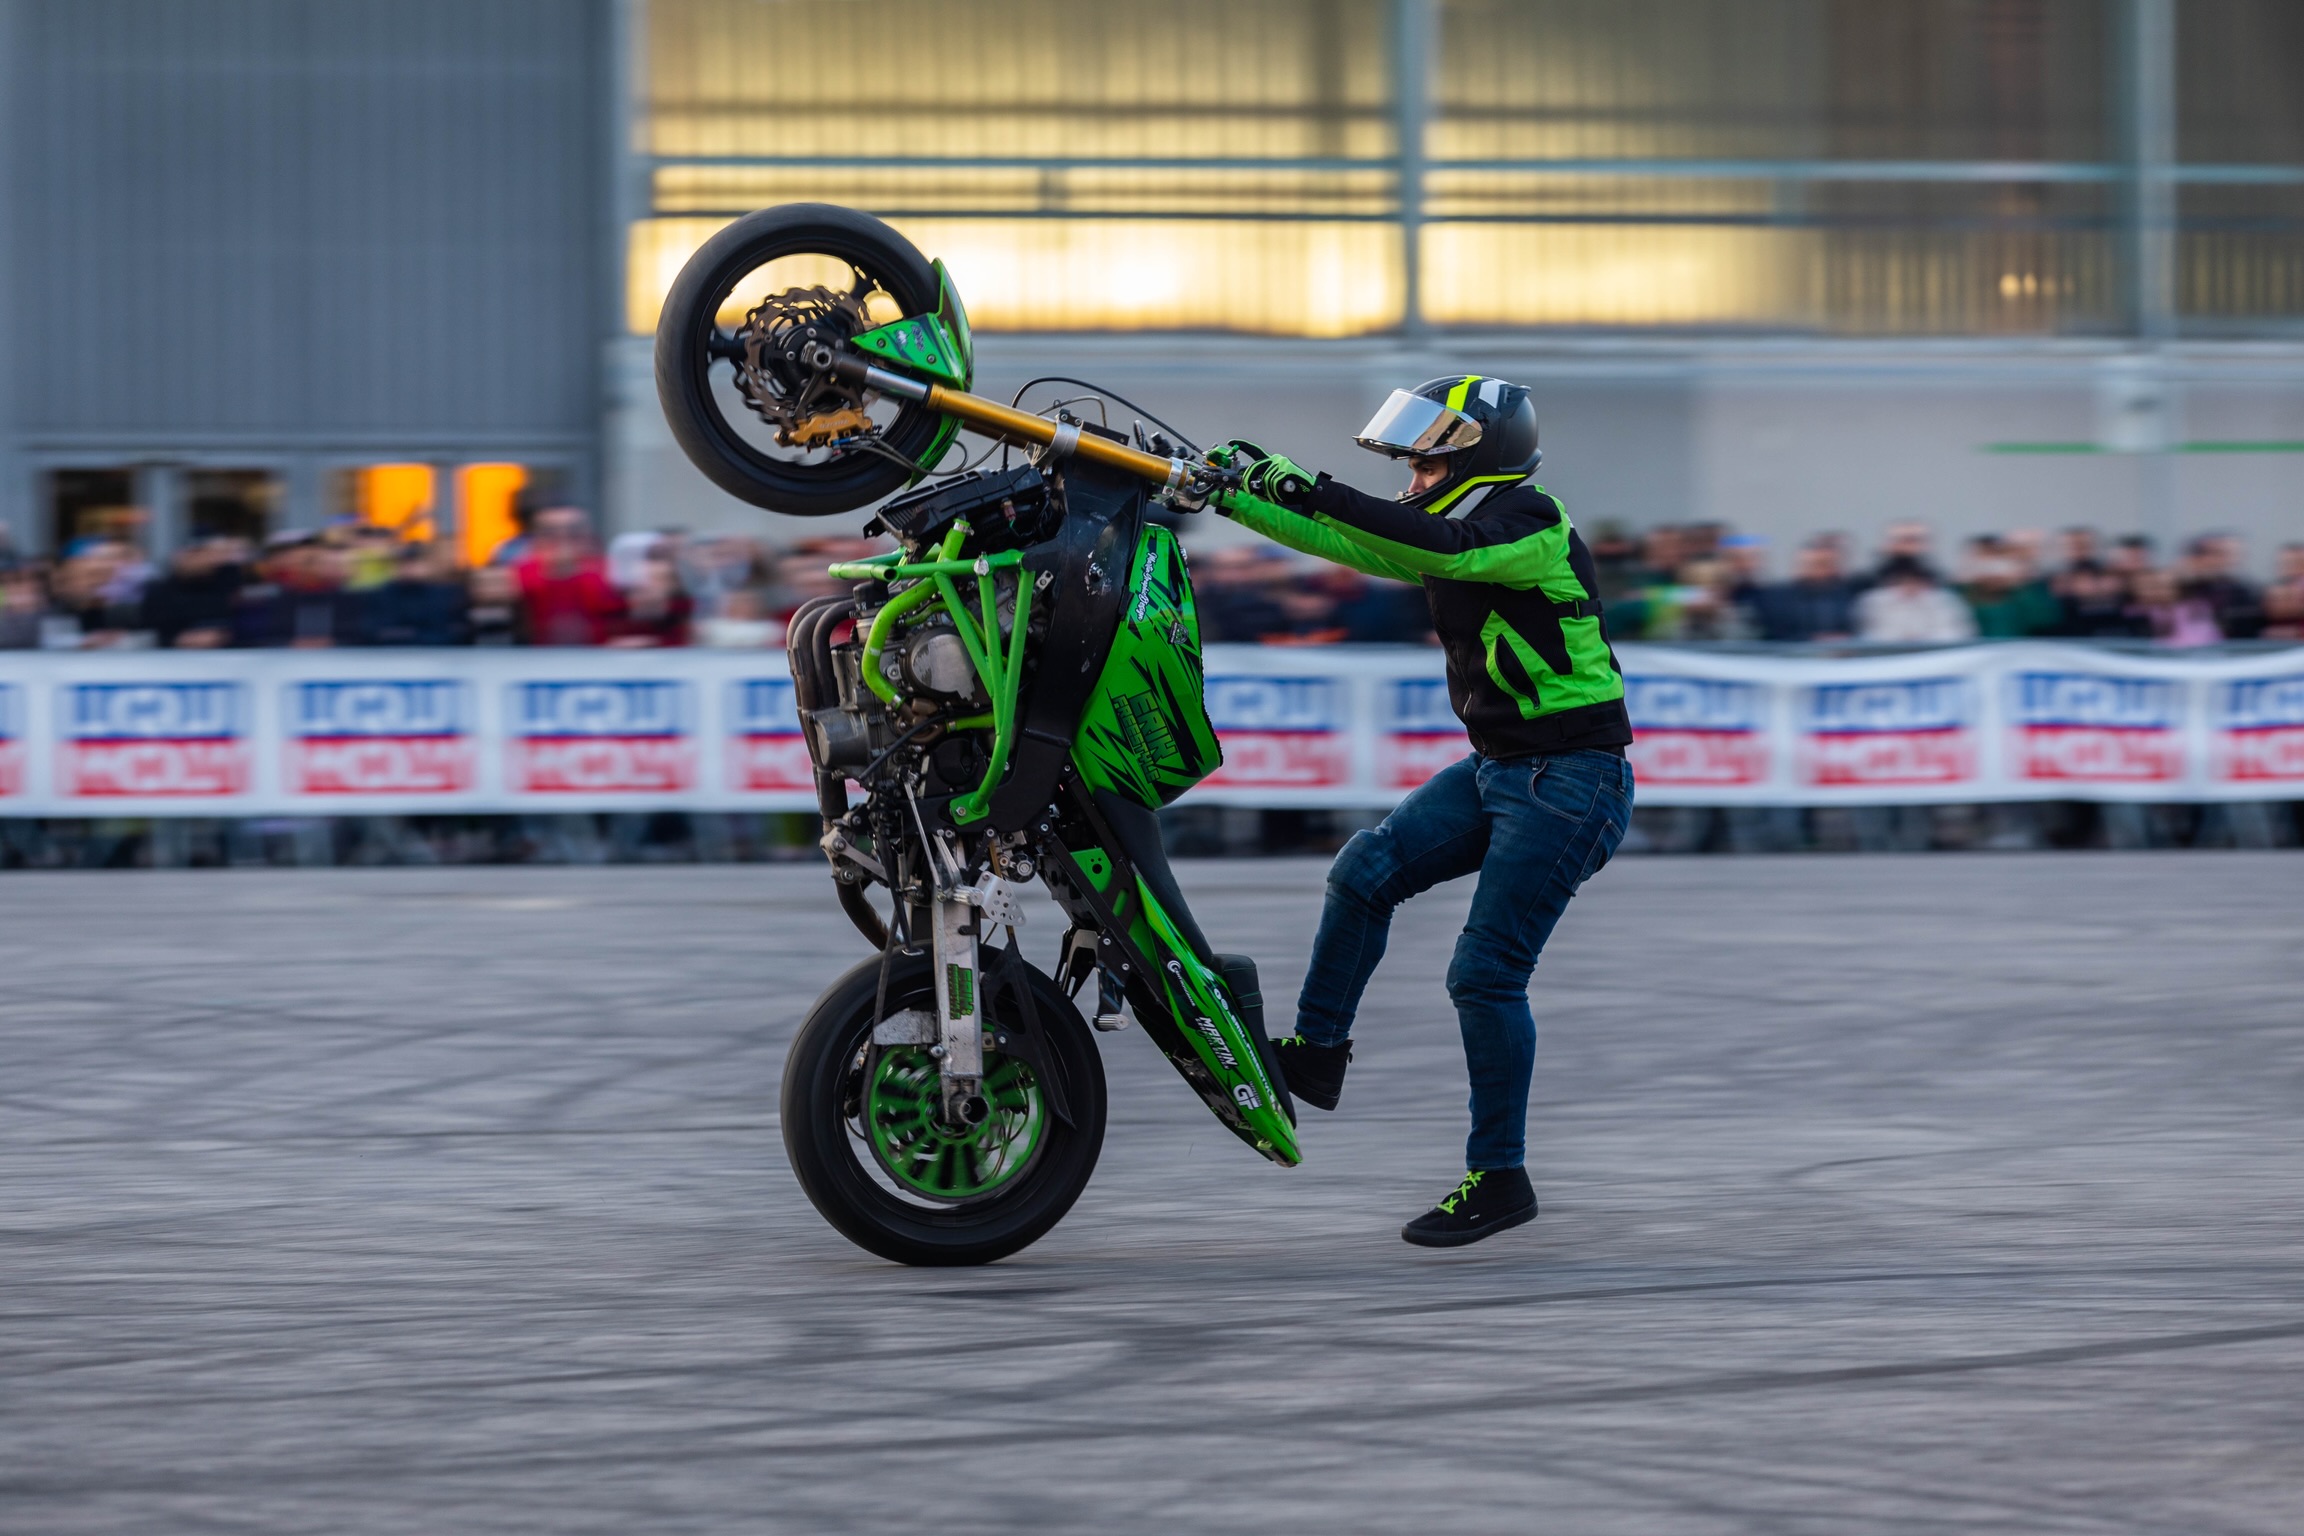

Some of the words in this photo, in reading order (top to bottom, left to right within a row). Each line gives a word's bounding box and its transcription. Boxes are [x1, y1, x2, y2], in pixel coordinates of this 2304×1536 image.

[1111, 694, 1160, 784] FREESTYLE
[1127, 690, 1178, 764] ERIK
[1199, 1016, 1238, 1066] MARTIN
